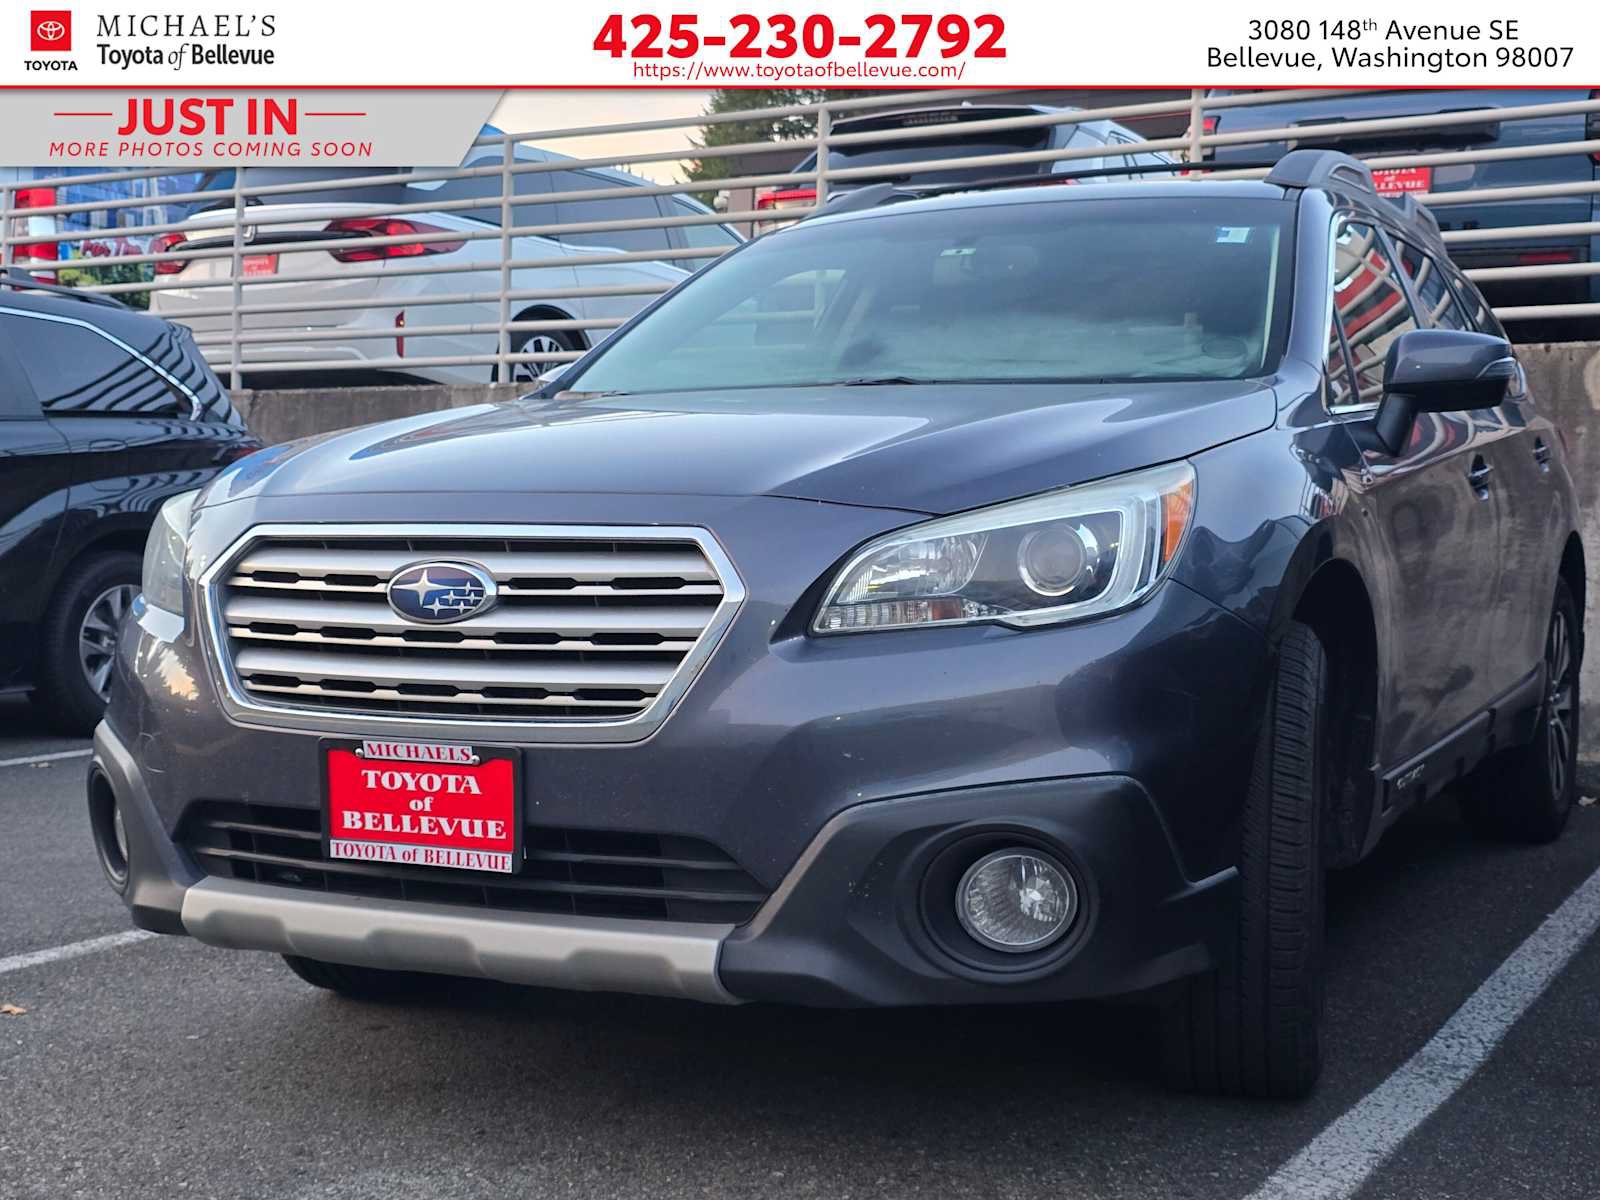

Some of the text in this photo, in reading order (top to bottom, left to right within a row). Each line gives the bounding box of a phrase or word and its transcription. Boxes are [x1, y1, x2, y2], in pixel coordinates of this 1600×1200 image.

[366, 742, 472, 761] MICHAELS
[361, 769, 482, 795] TOYOTA
[408, 796, 435, 812] of
[341, 810, 507, 840] BELLEVUE
[333, 842, 511, 871] TOYOTA of BELLEVUE
